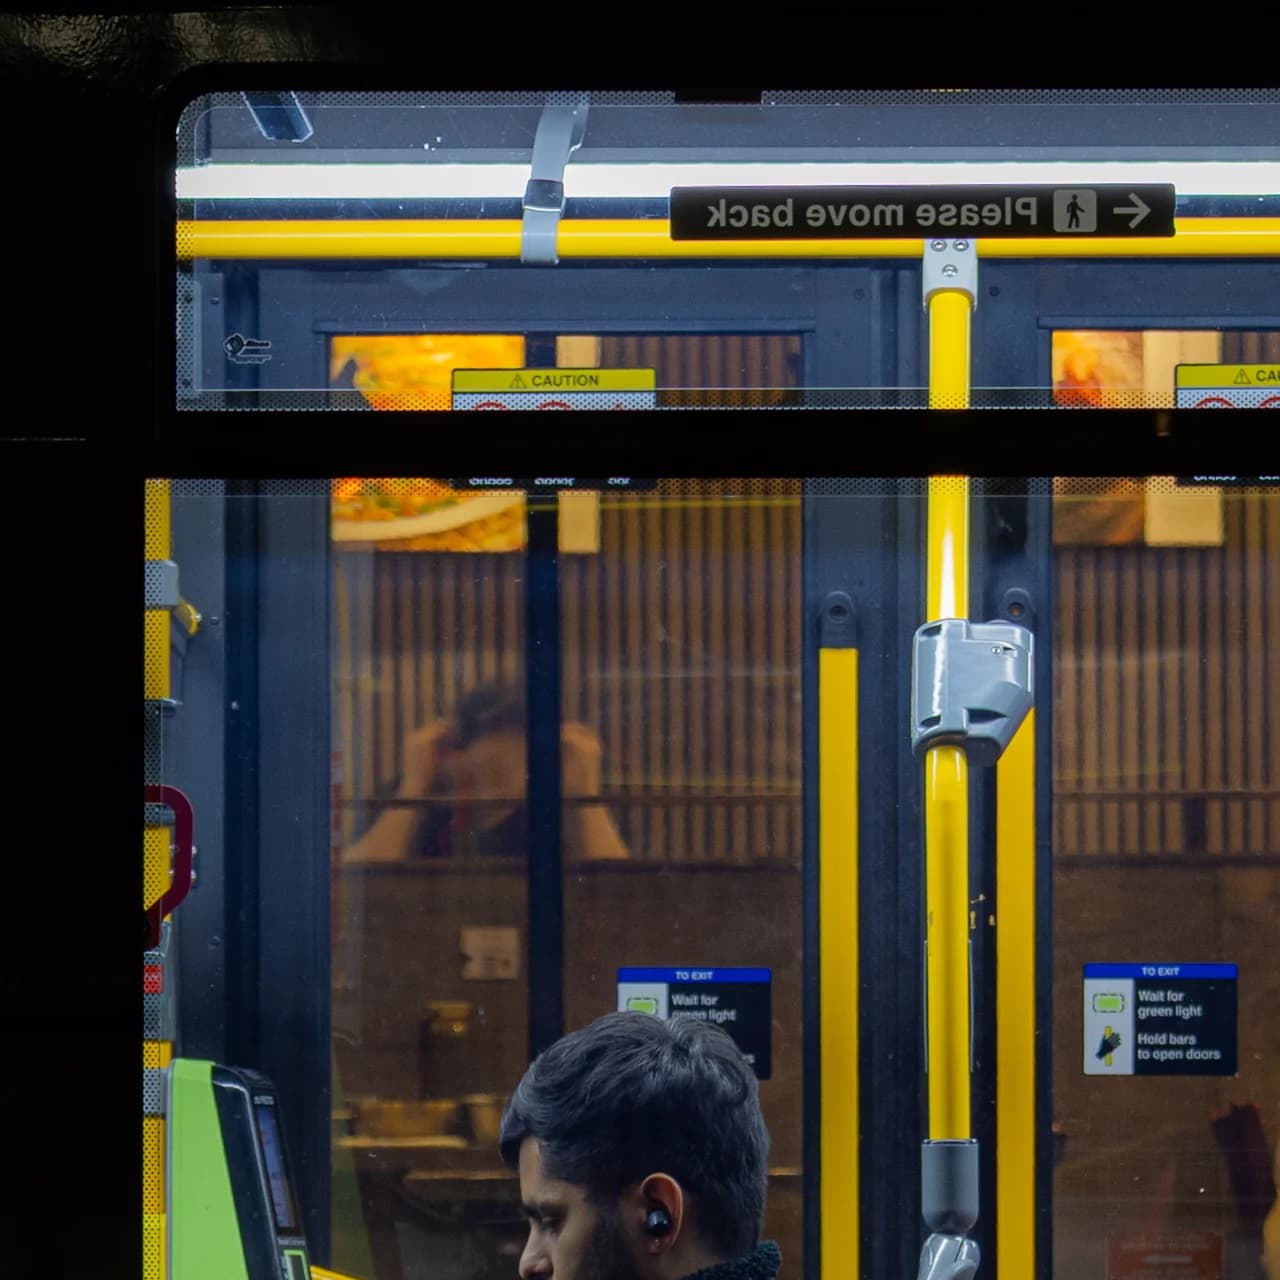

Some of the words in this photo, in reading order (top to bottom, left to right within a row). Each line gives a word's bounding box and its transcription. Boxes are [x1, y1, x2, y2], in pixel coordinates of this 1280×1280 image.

[531, 374, 600, 387] CAUTION
[675, 971, 689, 980] TO
[691, 971, 713, 980] EXIT
[1142, 967, 1156, 976] TO
[1158, 967, 1181, 976] EXIT
[671, 994, 699, 1006] Wait
[700, 994, 719, 1006] for
[1138, 990, 1165, 1002] Wait
[1166, 990, 1185, 1002] for
[708, 1009, 737, 1023] light
[1137, 1008, 1172, 1019] green
[1175, 1005, 1202, 1019] light
[1138, 1033, 1167, 1045] Hold
[1169, 1033, 1197, 1045] bars
[1138, 1050, 1150, 1060] to
[1152, 1051, 1183, 1062] open
[1186, 1050, 1221, 1060] doors
